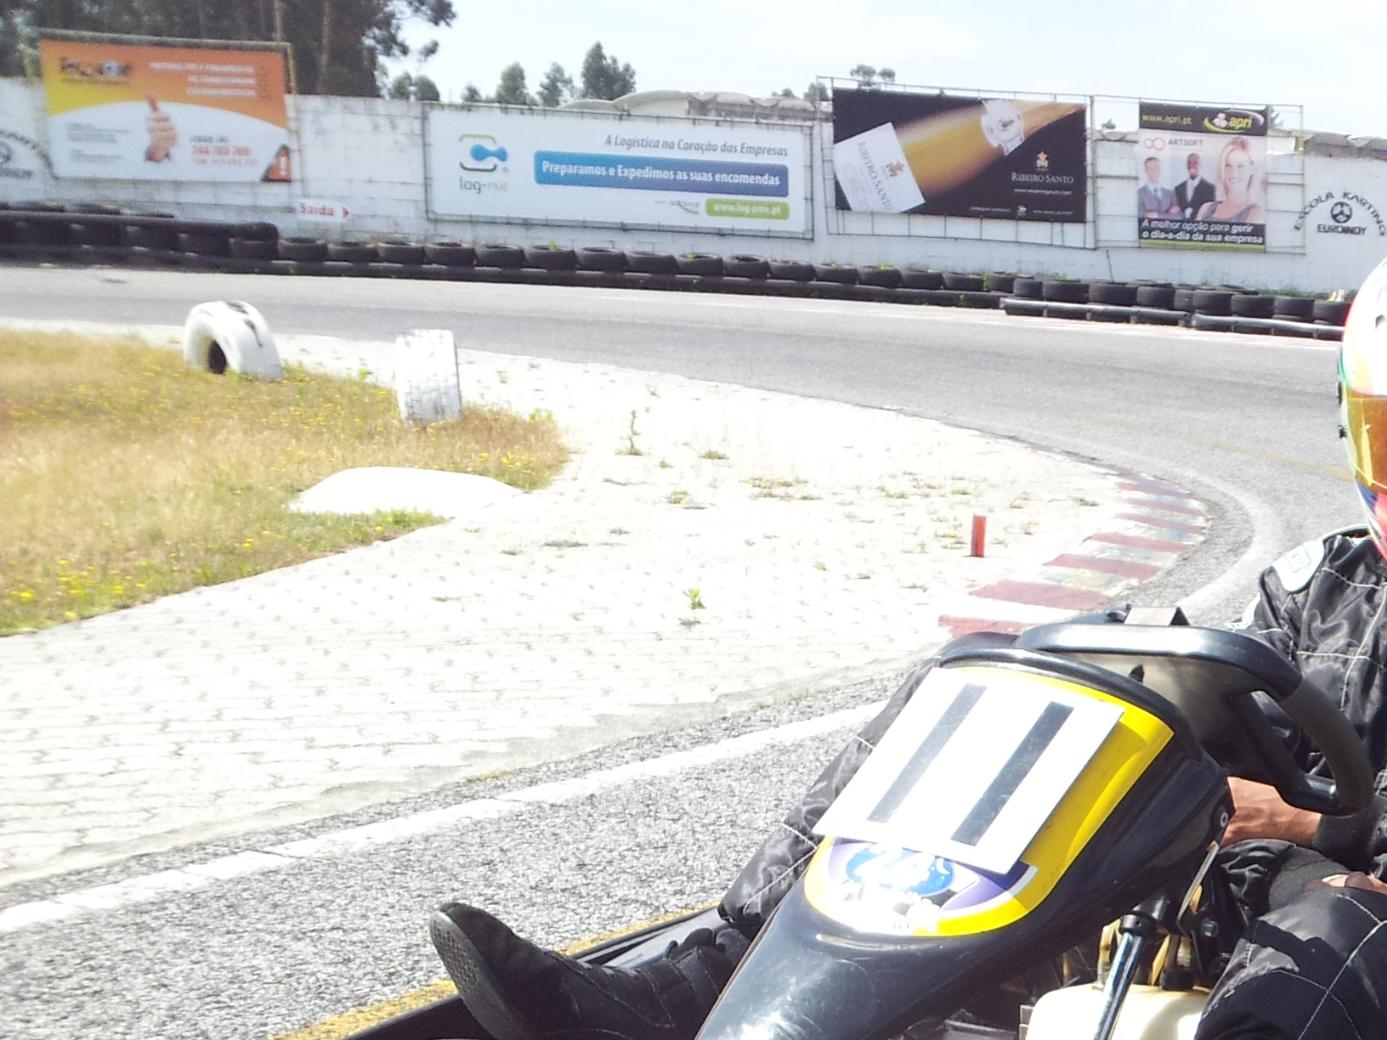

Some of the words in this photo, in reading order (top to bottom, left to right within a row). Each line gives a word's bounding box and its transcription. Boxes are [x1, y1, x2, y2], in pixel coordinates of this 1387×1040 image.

[1228, 116, 1254, 130] apri
[604, 134, 613, 146] A
[676, 138, 718, 155] Coração
[739, 144, 789, 158] Empresas
[541, 160, 608, 177] Preparamos
[608, 167, 616, 177] e
[617, 164, 675, 181] Expedimos
[675, 171, 689, 181] as
[689, 170, 714, 183] suas
[714, 171, 781, 186] encomendas
[1010, 171, 1045, 183] RIBEIRO
[1045, 173, 1074, 184] SANTO
[1231, 223, 1255, 234] gerir
